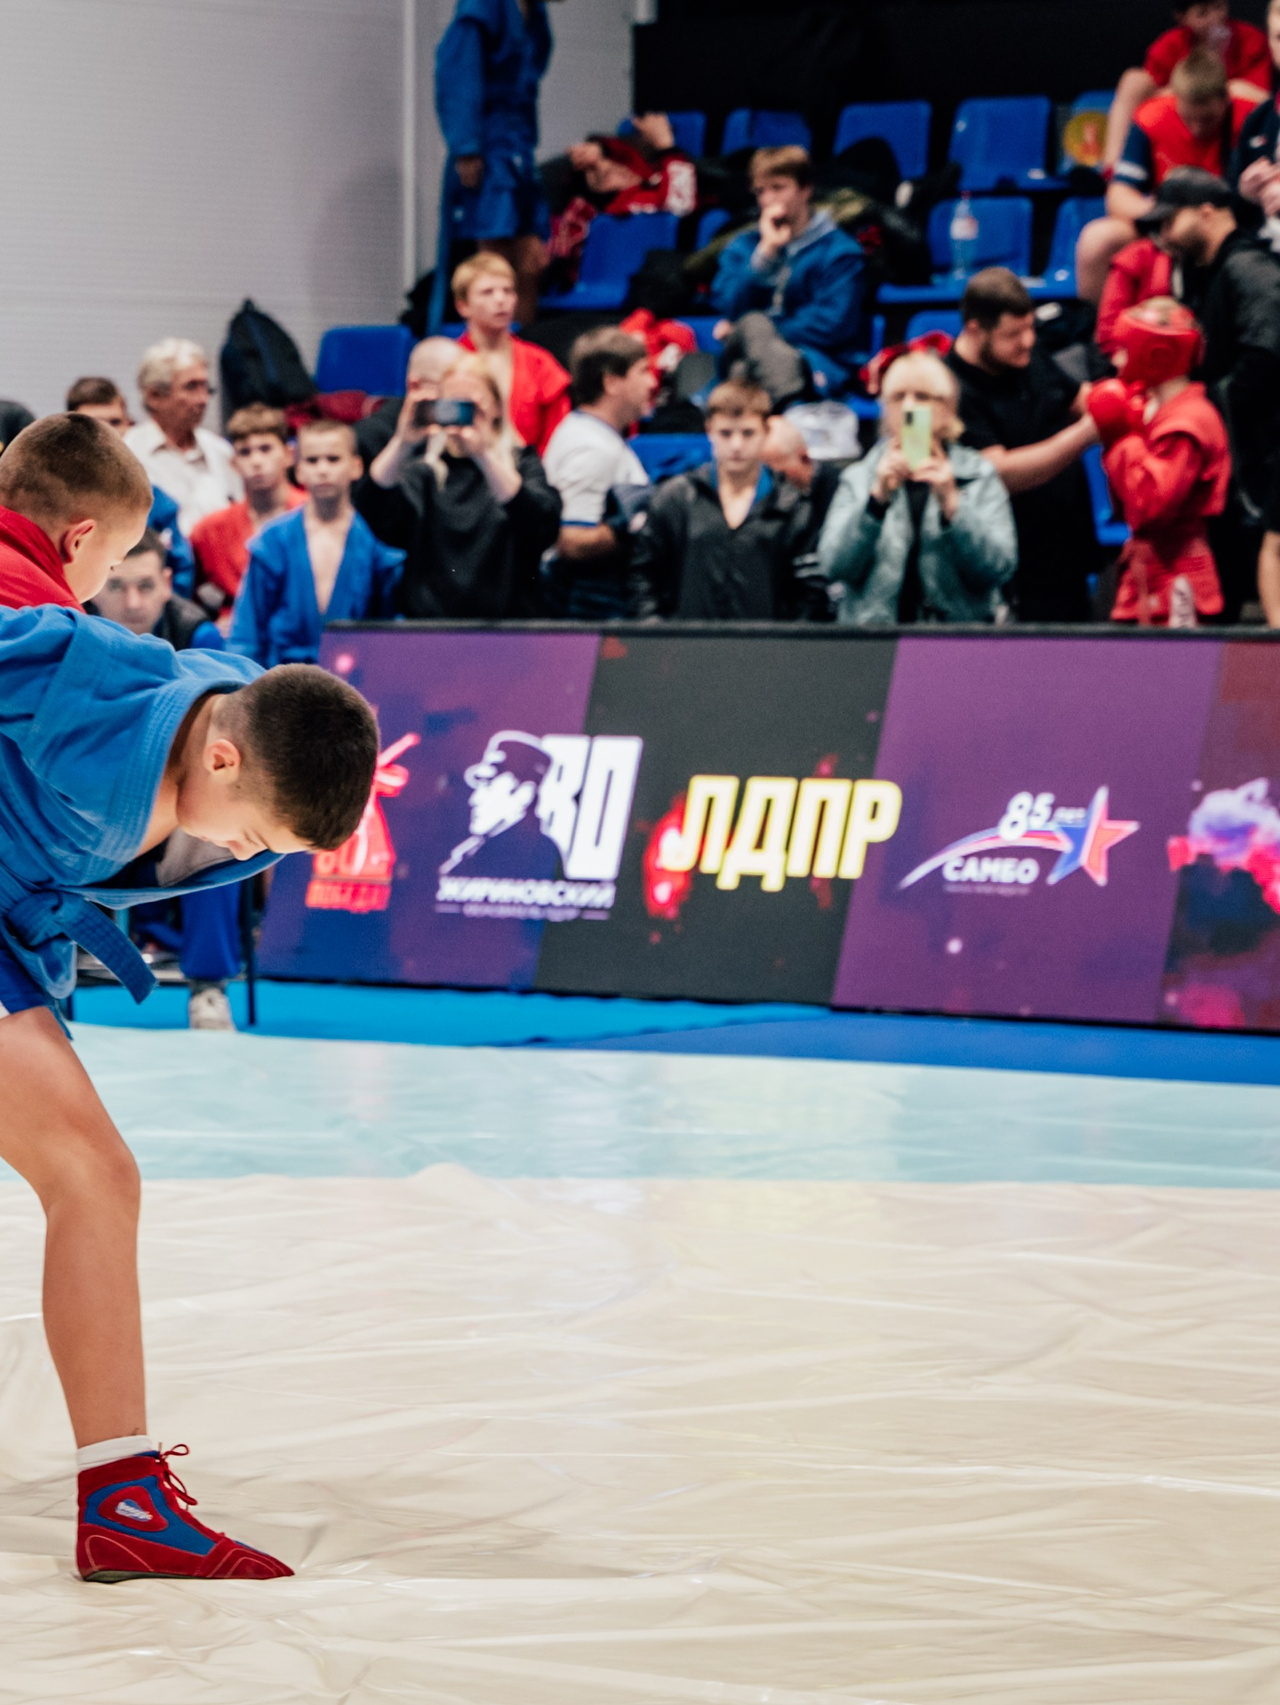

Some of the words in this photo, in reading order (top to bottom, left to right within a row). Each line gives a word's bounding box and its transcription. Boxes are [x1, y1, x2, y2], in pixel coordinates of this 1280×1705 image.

[661, 774, 902, 892] ЛДПР
[997, 791, 1056, 841] 85
[942, 856, 1040, 884] САМБО
